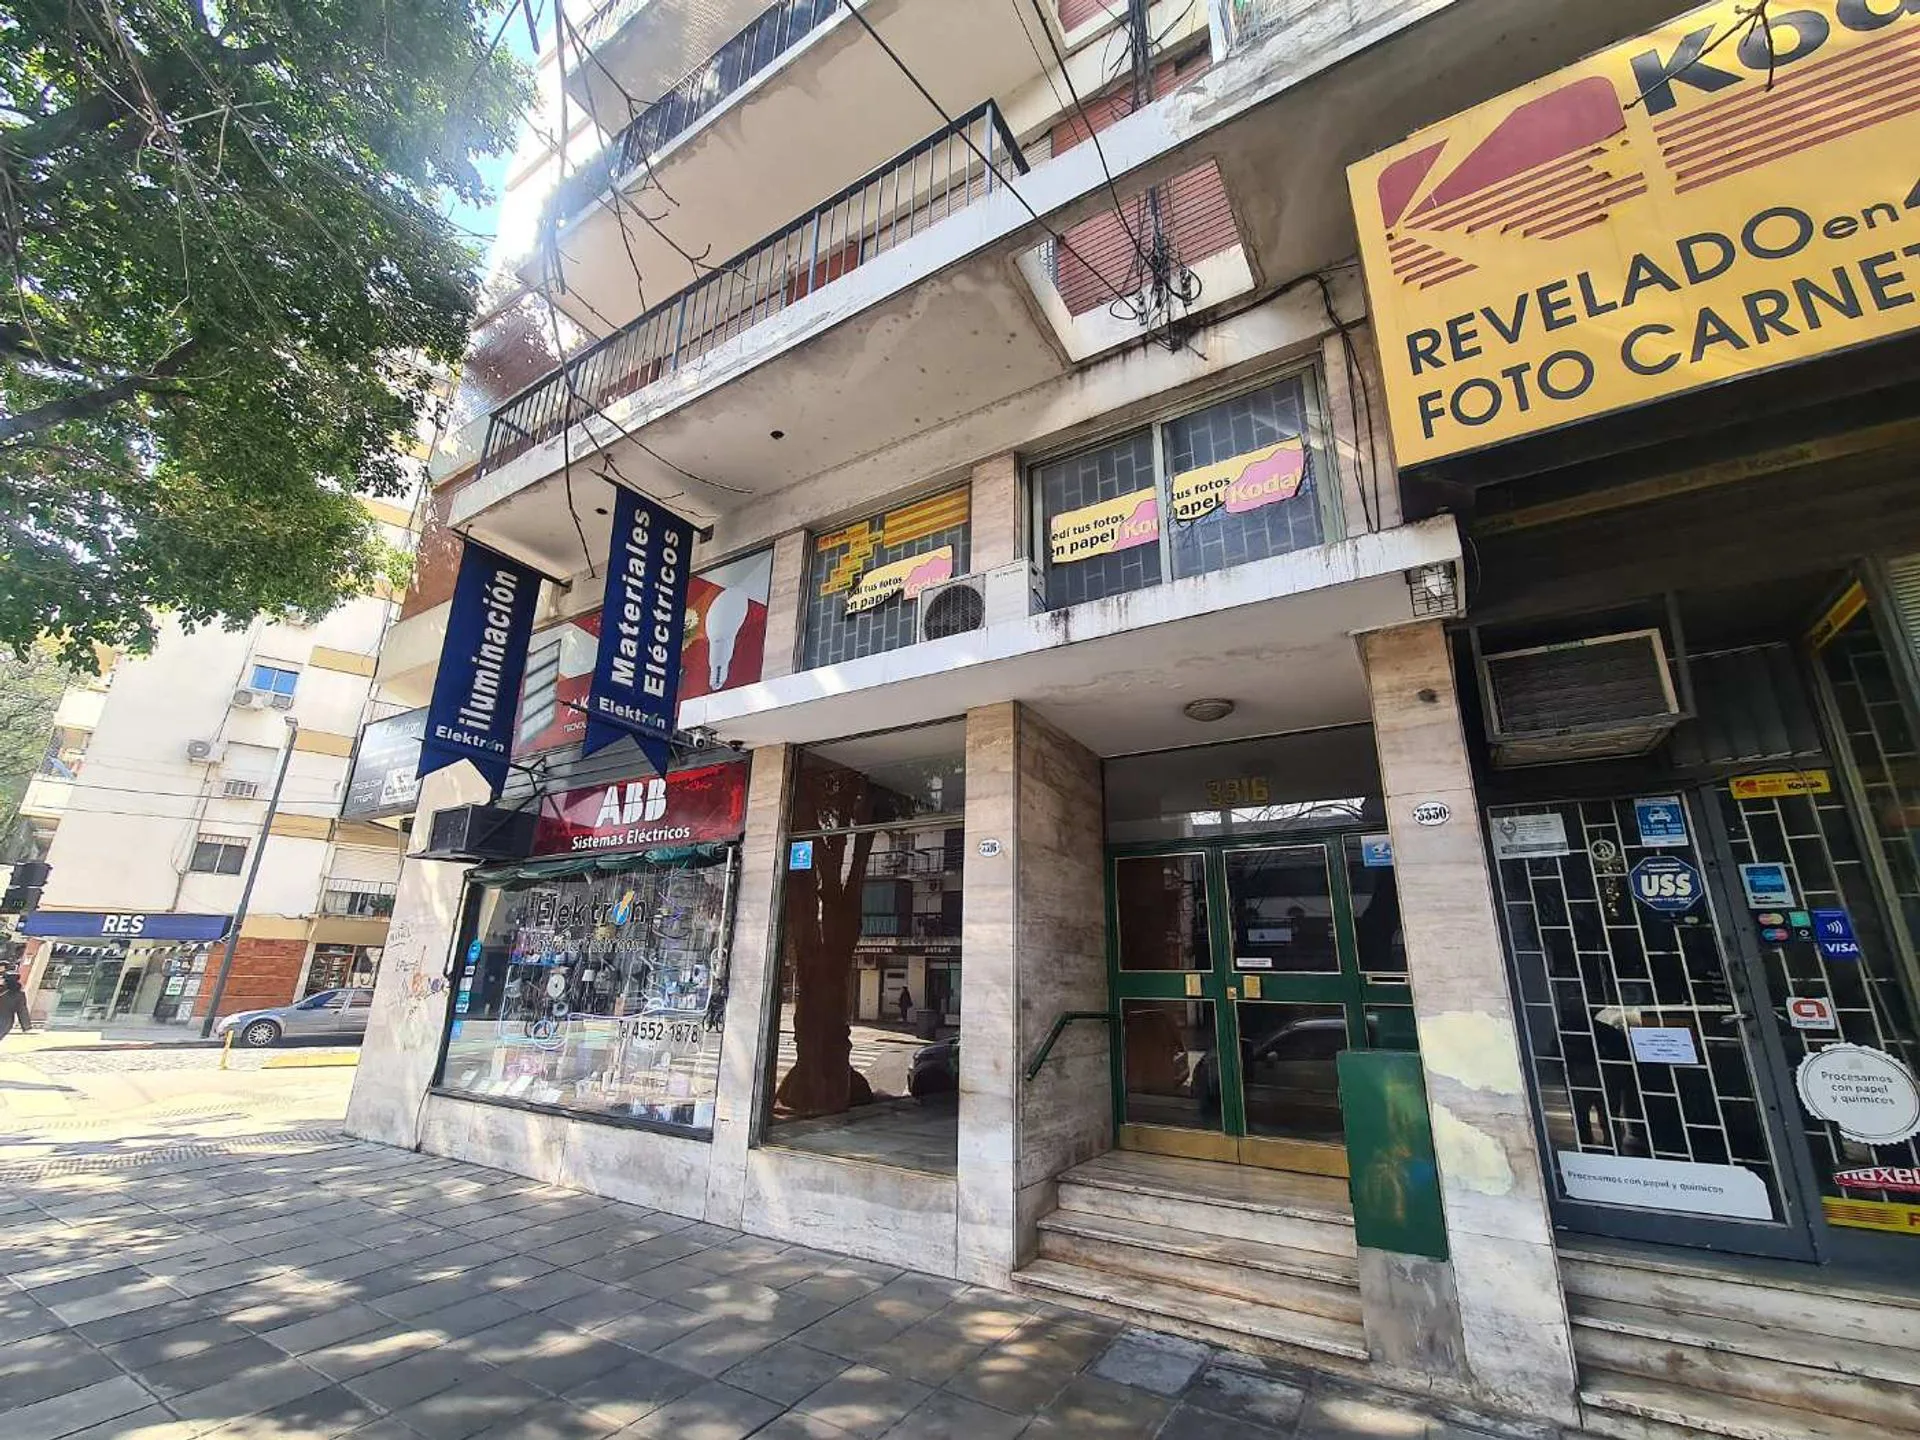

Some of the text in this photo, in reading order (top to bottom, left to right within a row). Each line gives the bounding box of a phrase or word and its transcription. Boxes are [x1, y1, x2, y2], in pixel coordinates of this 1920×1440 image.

[1405, 203, 1899, 375] REVELADO en
[1418, 349, 1595, 439] FOTO
[1195, 477, 1230, 495] fotos
[1073, 524, 1090, 535] tus
[1094, 514, 1125, 529] fotos
[1070, 529, 1115, 554] papel
[612, 508, 651, 687] Materiales
[643, 528, 679, 698] Eléctricos
[458, 569, 519, 731] iluminación
[595, 778, 667, 827] ABB
[572, 826, 690, 850] Sistemas Eléctricos
[1641, 873, 1691, 897] USS
[102, 915, 145, 933] RES
[1825, 943, 1859, 953] VISA
[1821, 1070, 1894, 1084] Procesamos
[1832, 1083, 1889, 1094] con papel
[1567, 1171, 1623, 1185] Procesamos
[1624, 1178, 1642, 1187] con
